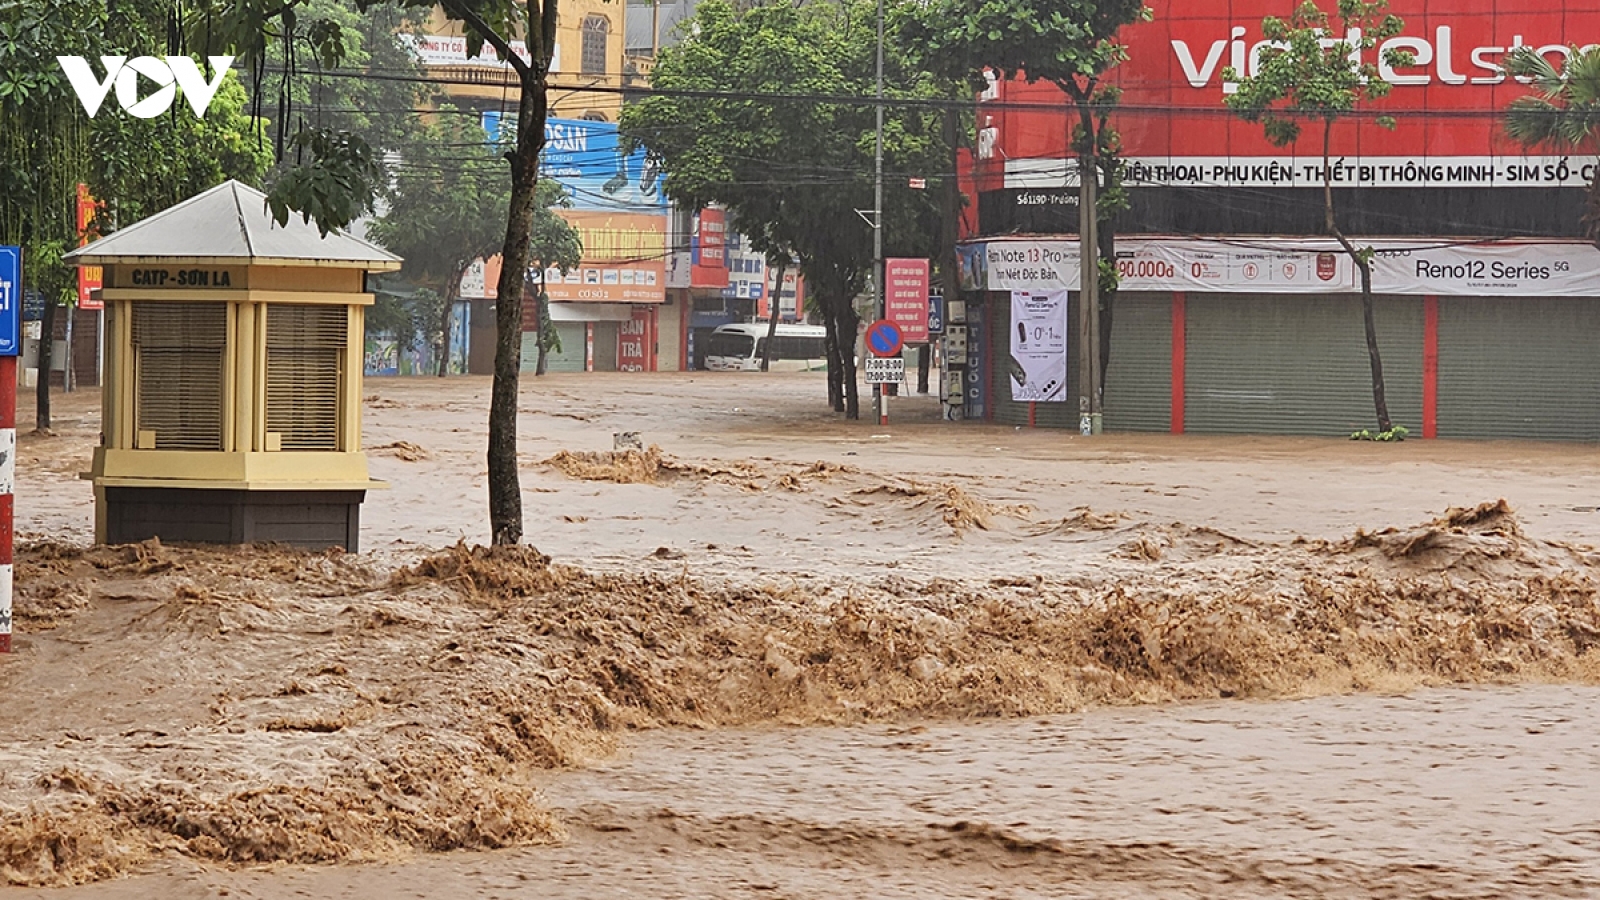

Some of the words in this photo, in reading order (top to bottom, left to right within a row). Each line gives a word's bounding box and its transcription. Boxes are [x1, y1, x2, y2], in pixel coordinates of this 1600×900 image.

[543, 123, 588, 151] OSAN
[1123, 160, 1153, 185] IỆN
[1154, 164, 1204, 185] THOẠI
[1212, 164, 1249, 185] PHỤ
[1251, 159, 1293, 185] KIỆN
[1303, 156, 1356, 182] THIẾT
[1359, 165, 1375, 186] BỊ
[1378, 160, 1443, 182] THÔNG
[1447, 164, 1494, 182] MINH
[1506, 164, 1539, 182] SIM
[1543, 156, 1569, 182] SỐ
[588, 217, 618, 259] THẤT
[1001, 248, 1025, 263] Note
[1027, 248, 1040, 263] 13
[1043, 248, 1062, 263] Pro
[212, 270, 231, 286] LA
[1022, 267, 1039, 283] Độc
[1040, 267, 1058, 280] Bản
[1116, 260, 1174, 278] 90.000đ
[1415, 259, 1486, 279] Reno12
[1491, 261, 1550, 280] Series
[1554, 261, 1569, 272] 5G
